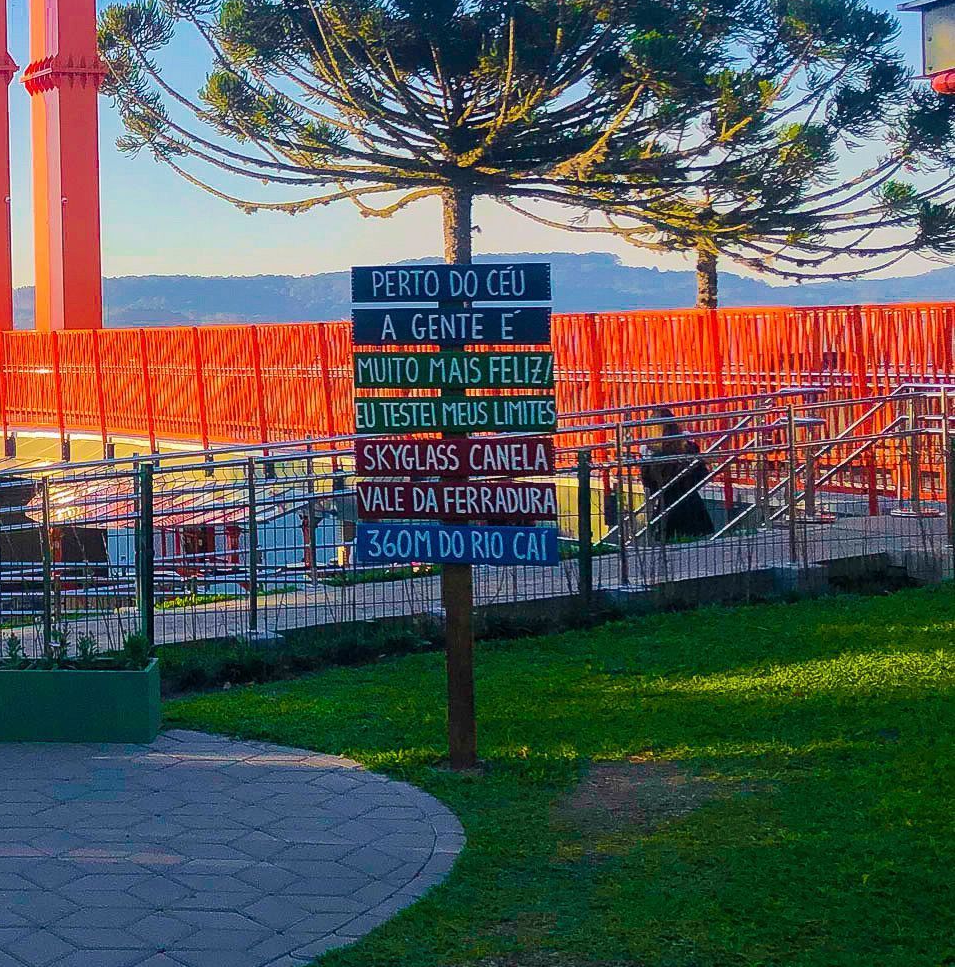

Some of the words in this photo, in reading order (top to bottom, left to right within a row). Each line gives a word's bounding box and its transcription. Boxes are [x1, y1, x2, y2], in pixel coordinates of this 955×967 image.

[372, 270, 439, 297] PERTO
[450, 270, 478, 297] DO
[486, 266, 525, 296] CÉU
[381, 314, 397, 341] A
[411, 314, 484, 340] GENTE
[502, 310, 521, 340] É
[357, 357, 417, 383] MUITO
[429, 357, 482, 384] MAIS
[355, 403, 375, 428] EU
[380, 402, 436, 427] TESTEI
[443, 402, 487, 425] MEUS
[493, 401, 556, 425] LIMITES
[364, 445, 459, 471] SKYGLASS
[469, 444, 548, 471] CANELA
[358, 486, 404, 512] VALE
[413, 487, 438, 513] DA
[444, 487, 556, 514] FERRADURA
[367, 530, 432, 558] 360M
[439, 531, 464, 558] DO
[472, 531, 504, 558] RIO
[513, 530, 549, 560] CAÍ
